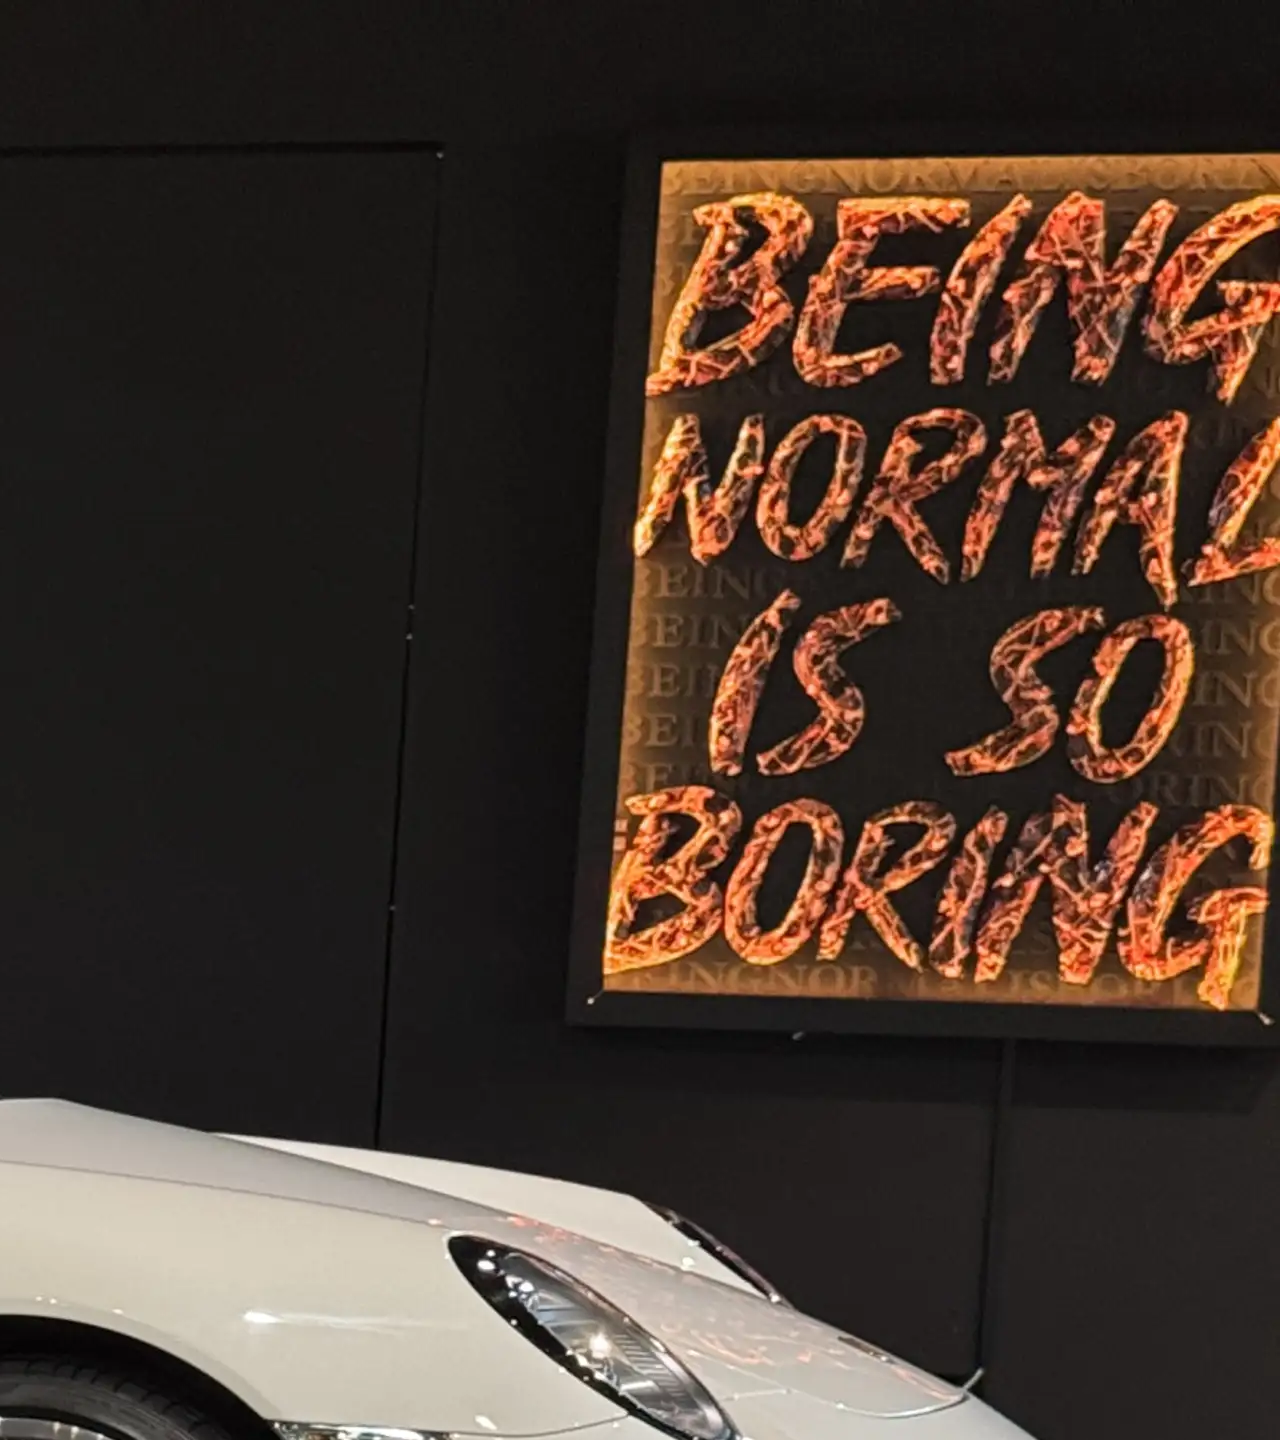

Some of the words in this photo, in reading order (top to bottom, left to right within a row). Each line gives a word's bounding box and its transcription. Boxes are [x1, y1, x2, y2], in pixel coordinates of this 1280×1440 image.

[645, 190, 1280, 405] BEING
[633, 407, 1280, 609] NORMAL
[708, 588, 902, 777] IS
[945, 605, 1193, 784] SO
[601, 786, 1275, 1011] BORING
